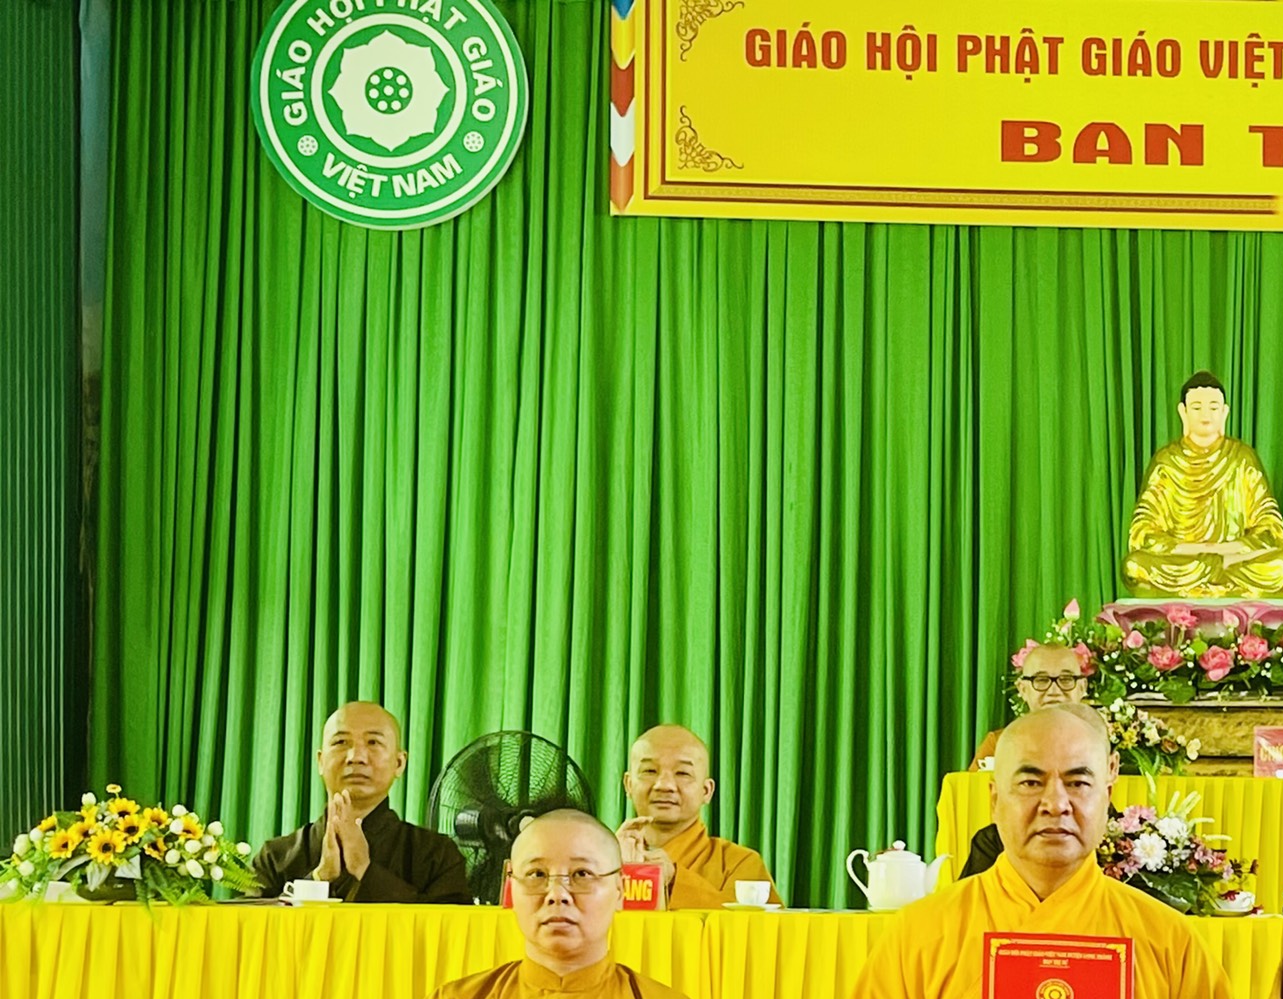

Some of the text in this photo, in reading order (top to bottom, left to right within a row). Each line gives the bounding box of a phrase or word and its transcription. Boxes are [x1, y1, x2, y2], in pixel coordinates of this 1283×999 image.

[745, 22, 847, 70] GIÁO
[866, 25, 938, 81] HỘI
[957, 25, 1064, 84] PHẬT
[1081, 31, 1181, 78] GIÁO
[276, 40, 312, 126] GIÁO
[463, 36, 503, 122] GIÁO
[1000, 120, 1205, 167] BAN
[321, 152, 464, 199] VIỆT NAM
[622, 875, 653, 901] ĂNG
